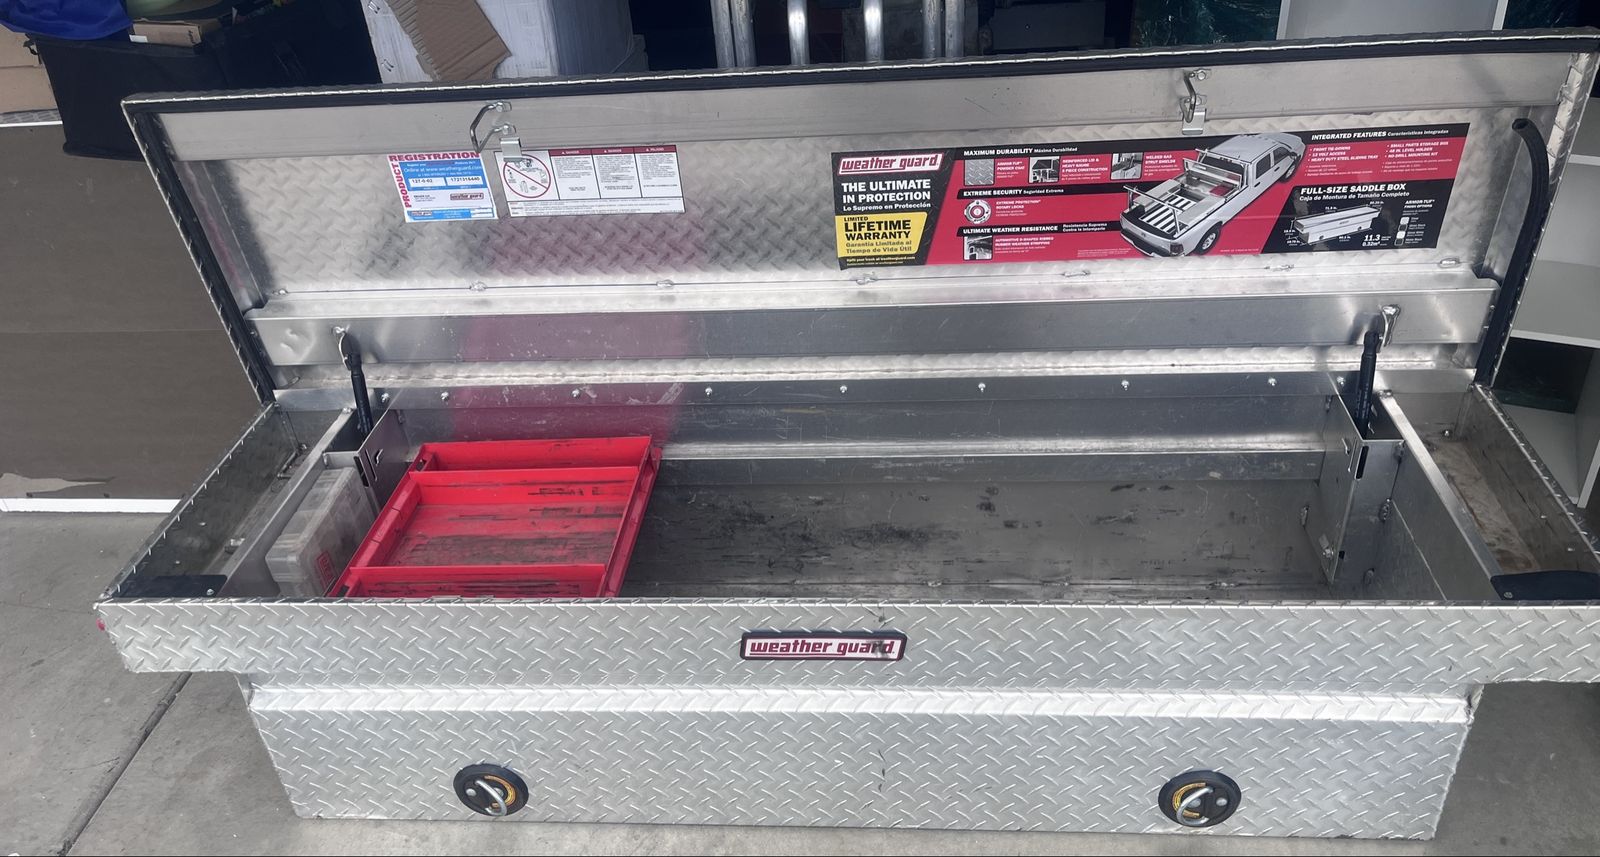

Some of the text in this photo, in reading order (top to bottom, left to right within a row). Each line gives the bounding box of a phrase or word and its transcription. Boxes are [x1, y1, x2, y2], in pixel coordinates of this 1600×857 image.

[388, 152, 480, 162] REGISTRATION
[842, 154, 938, 170] weather guard
[392, 163, 412, 208] PRODUCT
[842, 179, 931, 192] THE ULTIMATE
[1301, 187, 1348, 195] FULL-SIZE
[1350, 185, 1385, 193] SADDLE
[842, 191, 931, 203] IN PROTECTION
[844, 220, 911, 232] LIFETIME
[846, 231, 910, 241] WARRANTY
[750, 640, 895, 654] weather guard
